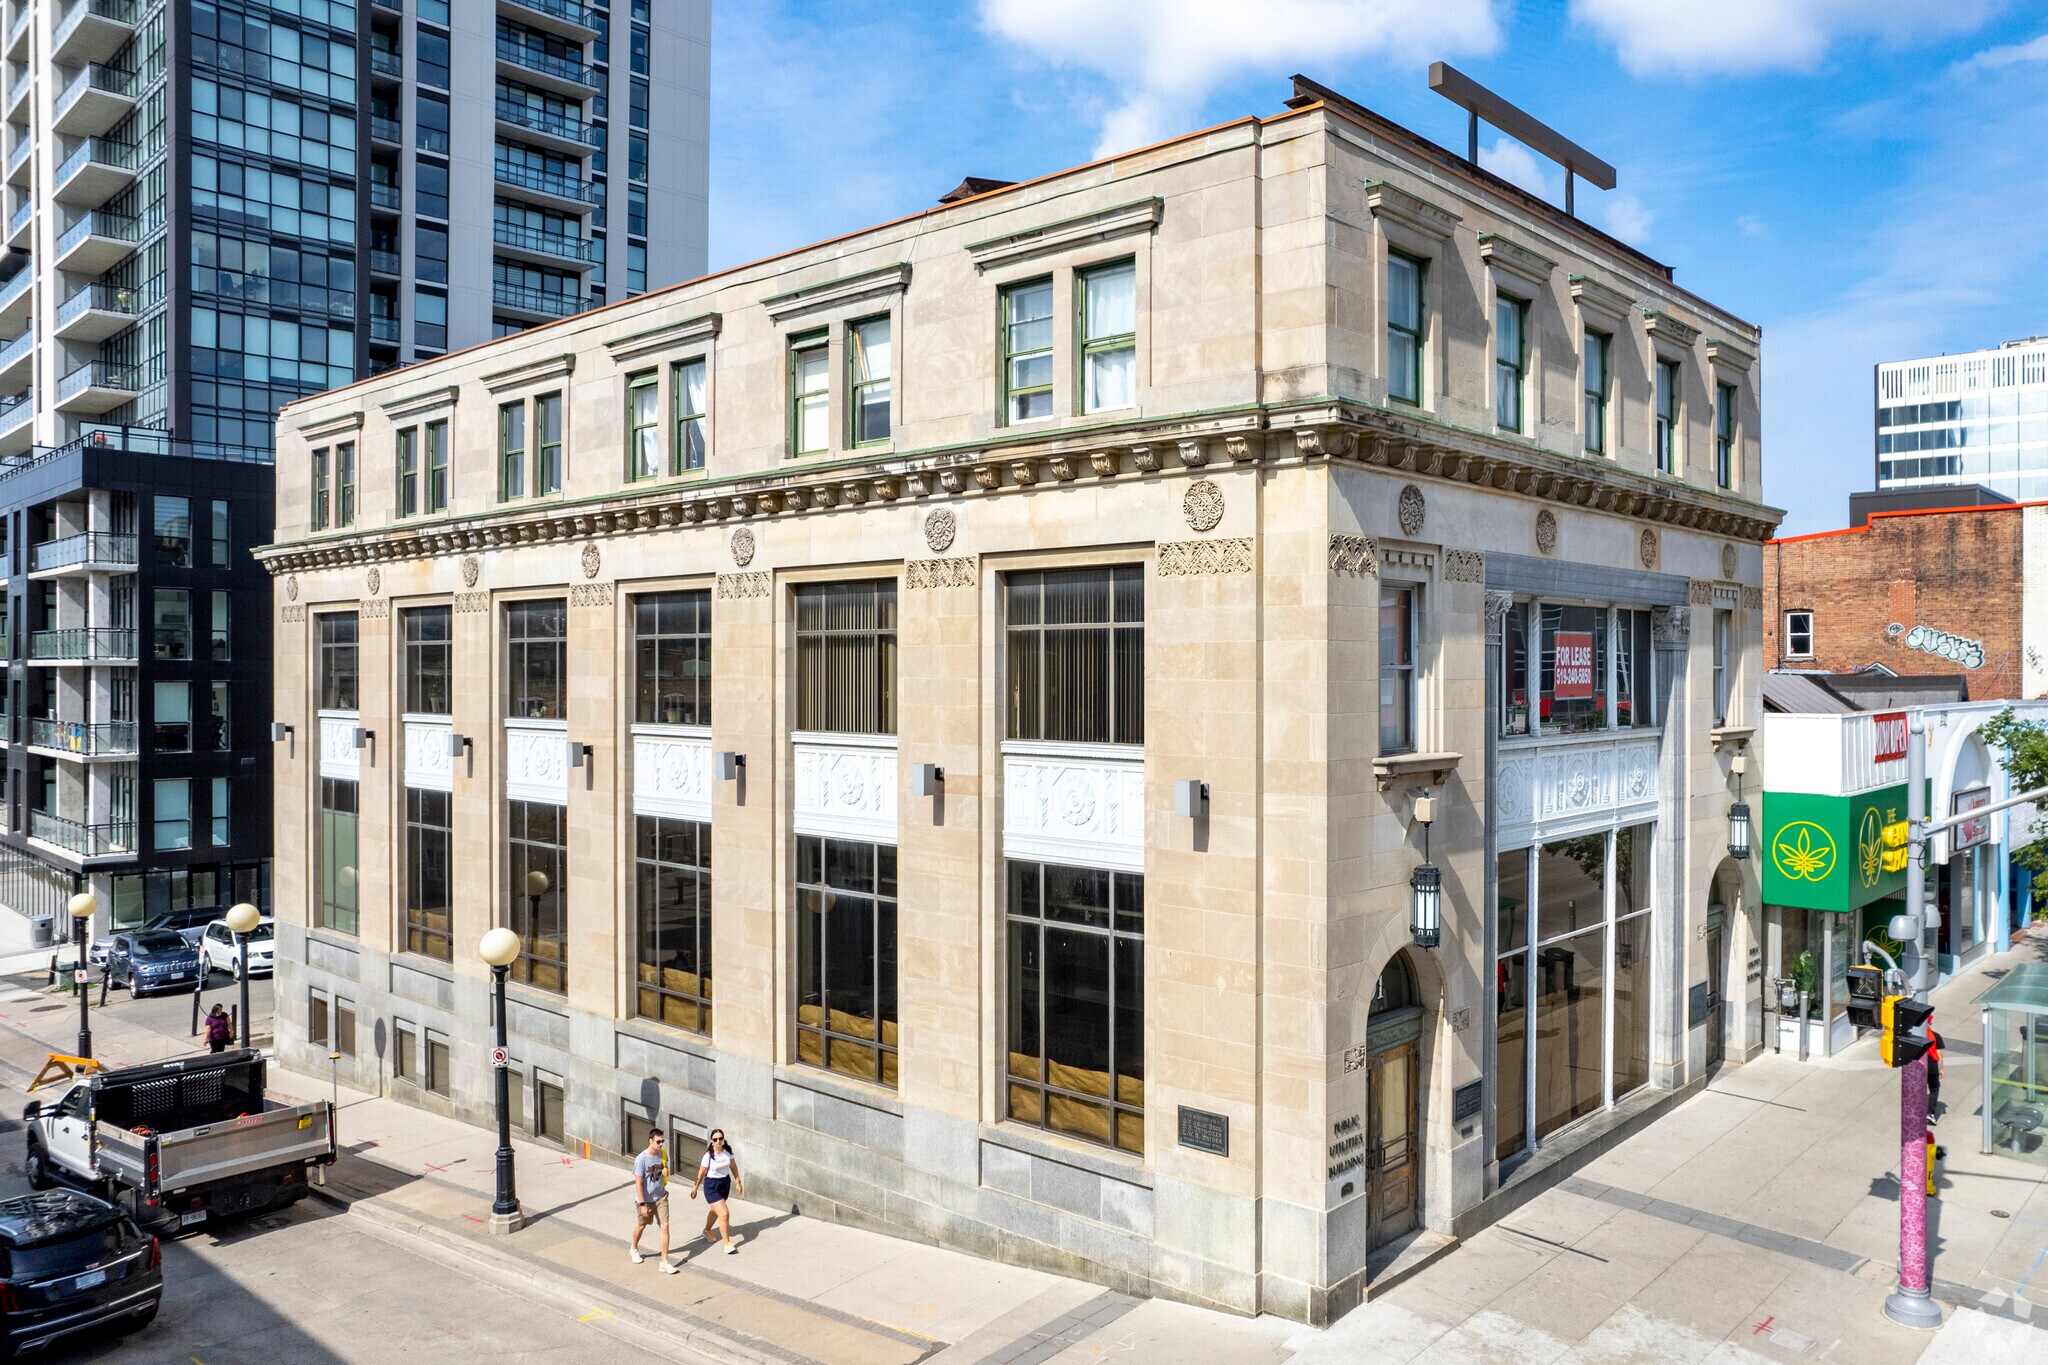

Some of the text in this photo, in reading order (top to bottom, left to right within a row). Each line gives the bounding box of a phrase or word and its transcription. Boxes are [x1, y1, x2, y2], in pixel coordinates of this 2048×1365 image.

[1556, 646, 1591, 666] FOR LEASE
[1334, 1114, 1361, 1135] PUBLIC
[1328, 1133, 1365, 1157] UTILITIES
[1328, 1153, 1365, 1178] BUILDING
